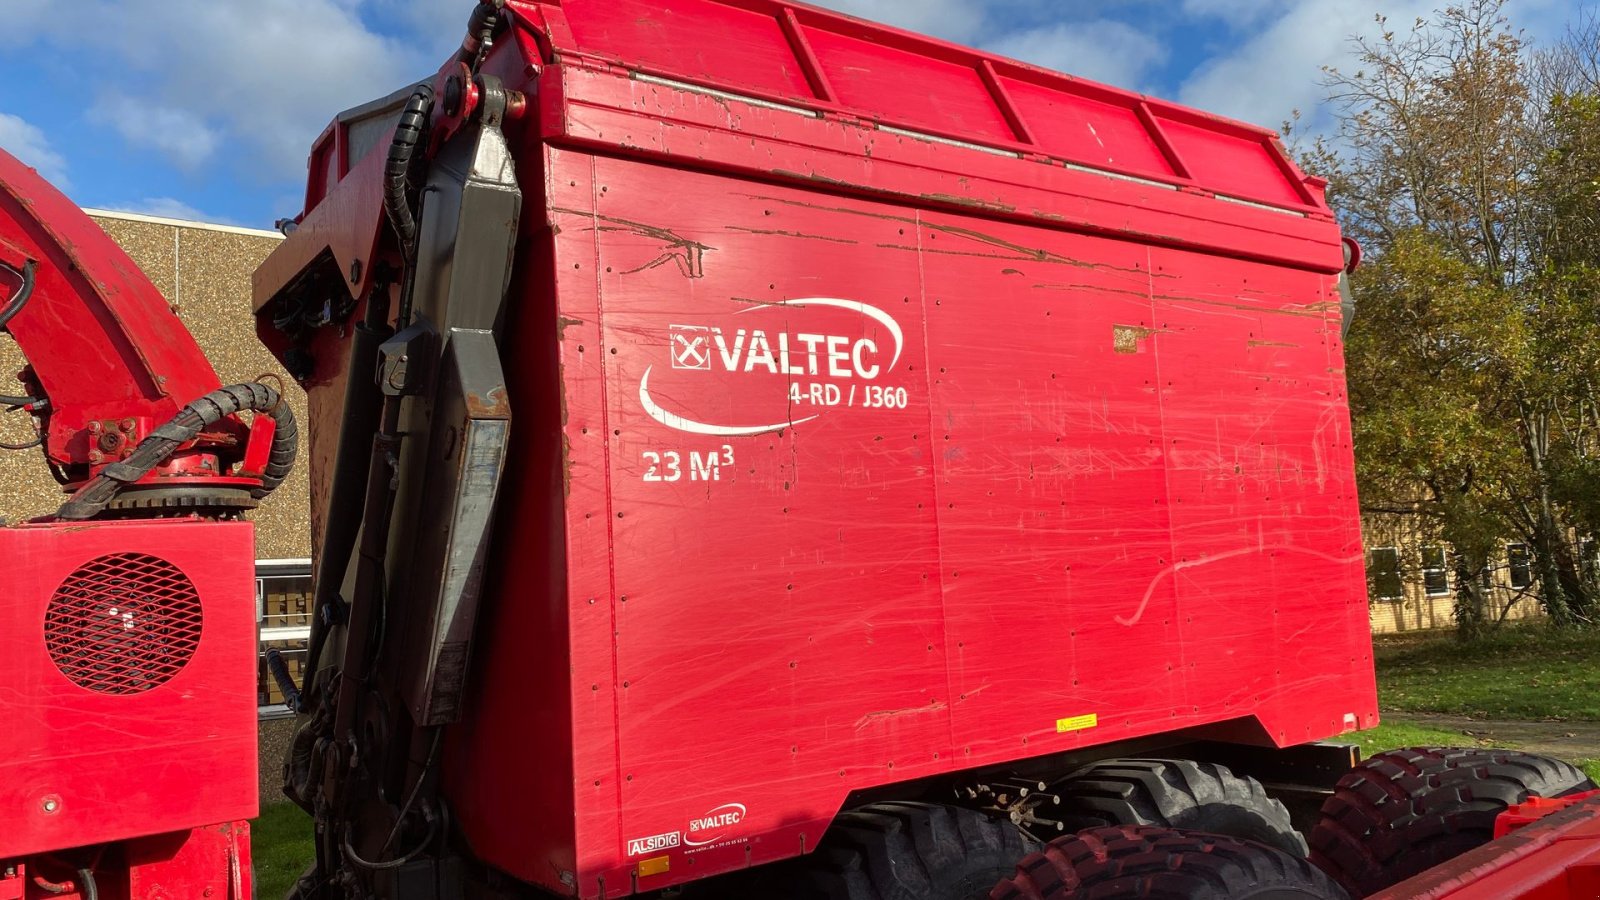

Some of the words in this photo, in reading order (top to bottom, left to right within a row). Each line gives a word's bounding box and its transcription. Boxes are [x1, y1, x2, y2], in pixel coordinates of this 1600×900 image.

[711, 326, 880, 379] VALTEC
[788, 382, 841, 406] 4-RD
[863, 385, 908, 409] J360
[642, 451, 681, 482] 23
[699, 812, 740, 829] VALTEC
[631, 834, 677, 855] ALSIDIG
